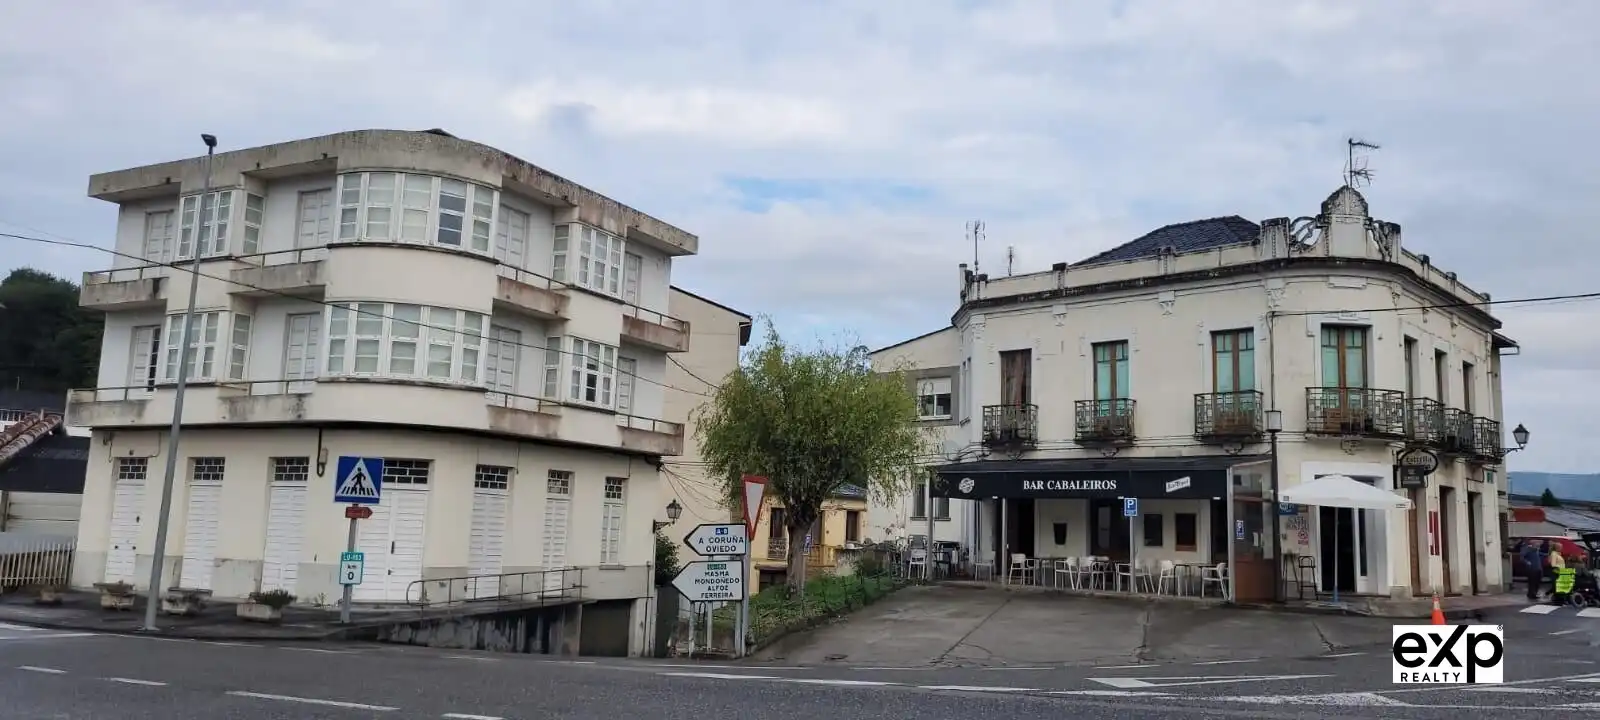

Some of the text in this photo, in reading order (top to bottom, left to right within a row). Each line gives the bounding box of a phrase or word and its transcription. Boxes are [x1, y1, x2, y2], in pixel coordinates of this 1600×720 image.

[1023, 480, 1117, 490] BAR CABALEIROS
[708, 536, 744, 544] CORUÑA
[706, 545, 737, 553] OVIEDO
[347, 571, 354, 581] 0
[694, 576, 740, 585] MONDOÑEDO
